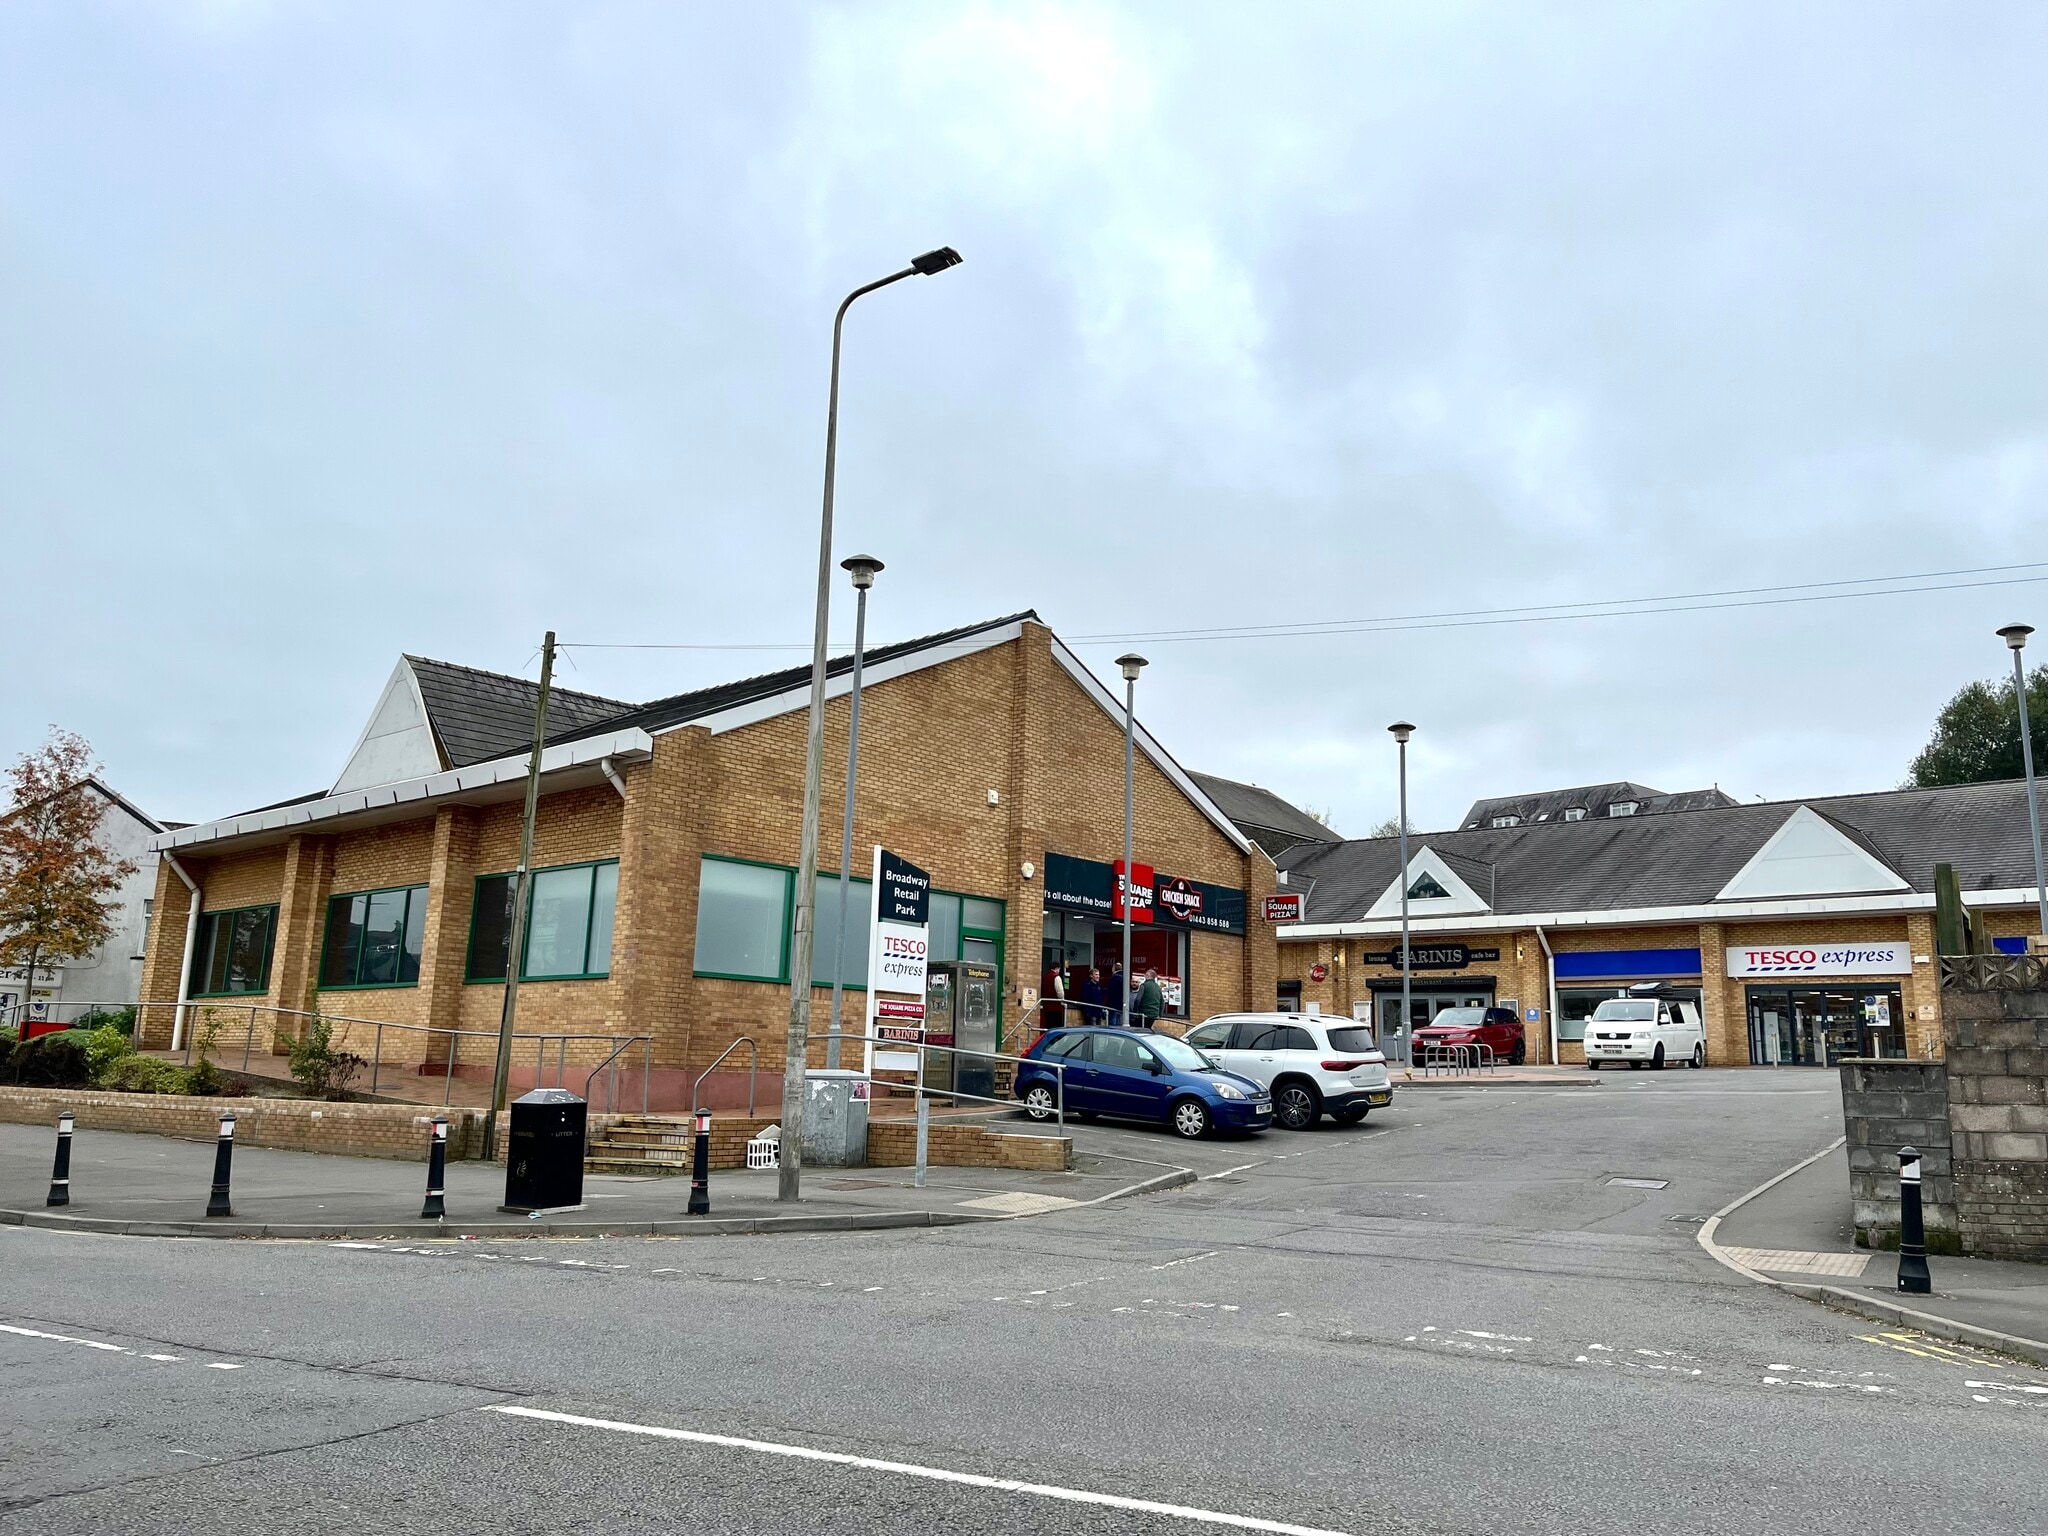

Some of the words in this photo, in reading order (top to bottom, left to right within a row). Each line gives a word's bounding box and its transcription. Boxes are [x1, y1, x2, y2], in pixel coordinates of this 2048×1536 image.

[886, 870, 928, 889] Broadway
[894, 887, 919, 901] Retail
[1118, 880, 1153, 899] SUARE
[1052, 891, 1061, 900] all
[1062, 893, 1082, 903] about
[1082, 896, 1093, 906] the
[1120, 895, 1146, 908] PZZA
[1162, 889, 1184, 904] CHICKEN
[1184, 893, 1200, 908] SHACK
[895, 903, 916, 916] Park
[1268, 903, 1297, 911] SQUARE
[1189, 914, 1206, 925] 01443
[1206, 917, 1218, 927] 858
[1219, 919, 1230, 929] 588
[1270, 911, 1291, 919] PIZZA
[884, 936, 926, 955] TESCO
[1368, 955, 1387, 963] lounge
[1745, 950, 1817, 965] TESCO
[1821, 949, 1894, 967] express
[884, 962, 924, 978] express
[968, 969, 989, 977] Telephone
[883, 1028, 919, 1041] BARINIS
